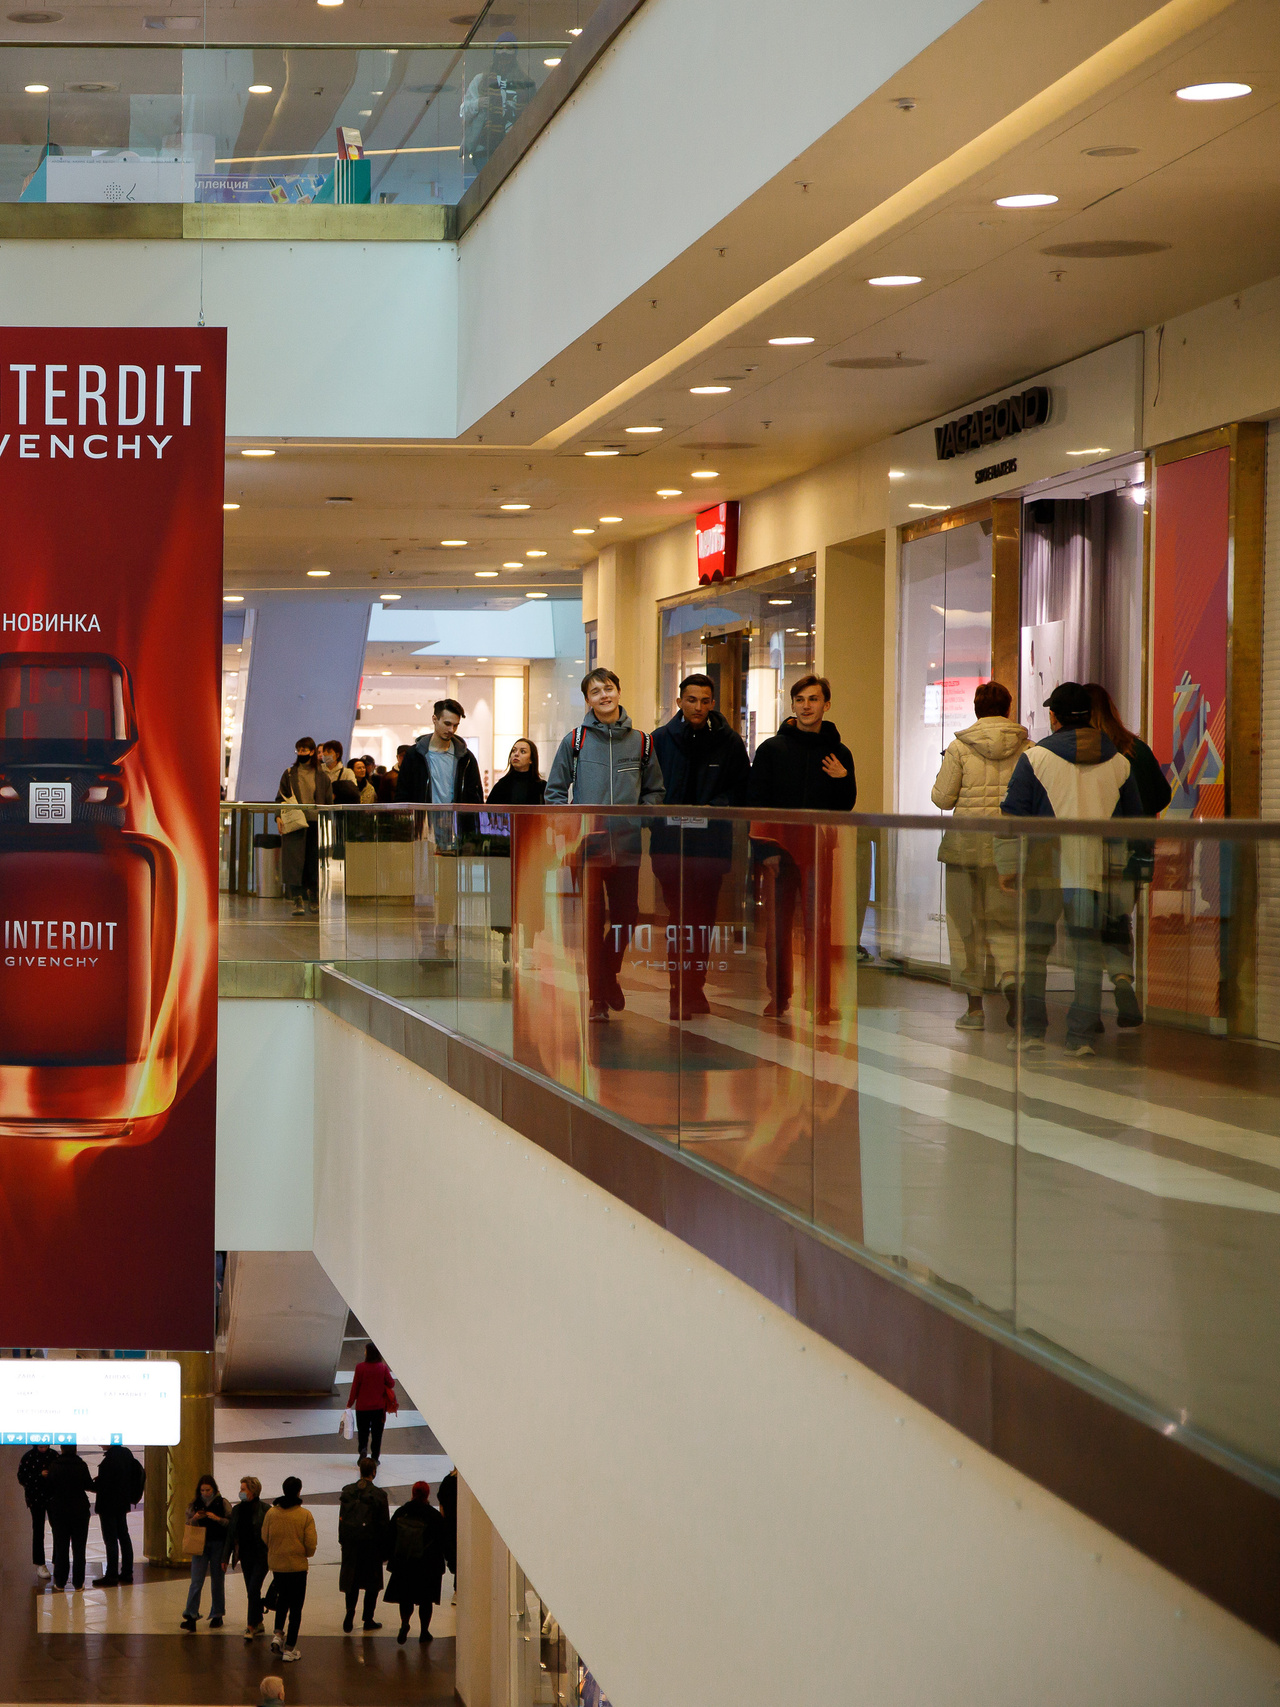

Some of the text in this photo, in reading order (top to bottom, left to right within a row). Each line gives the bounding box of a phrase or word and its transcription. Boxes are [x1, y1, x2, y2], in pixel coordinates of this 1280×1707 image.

[195, 179, 249, 191] ллекция
[934, 386, 1050, 460] VAGABOND
[2, 612, 101, 633] НОВИНКА
[5, 956, 99, 968] GIVENCHY
